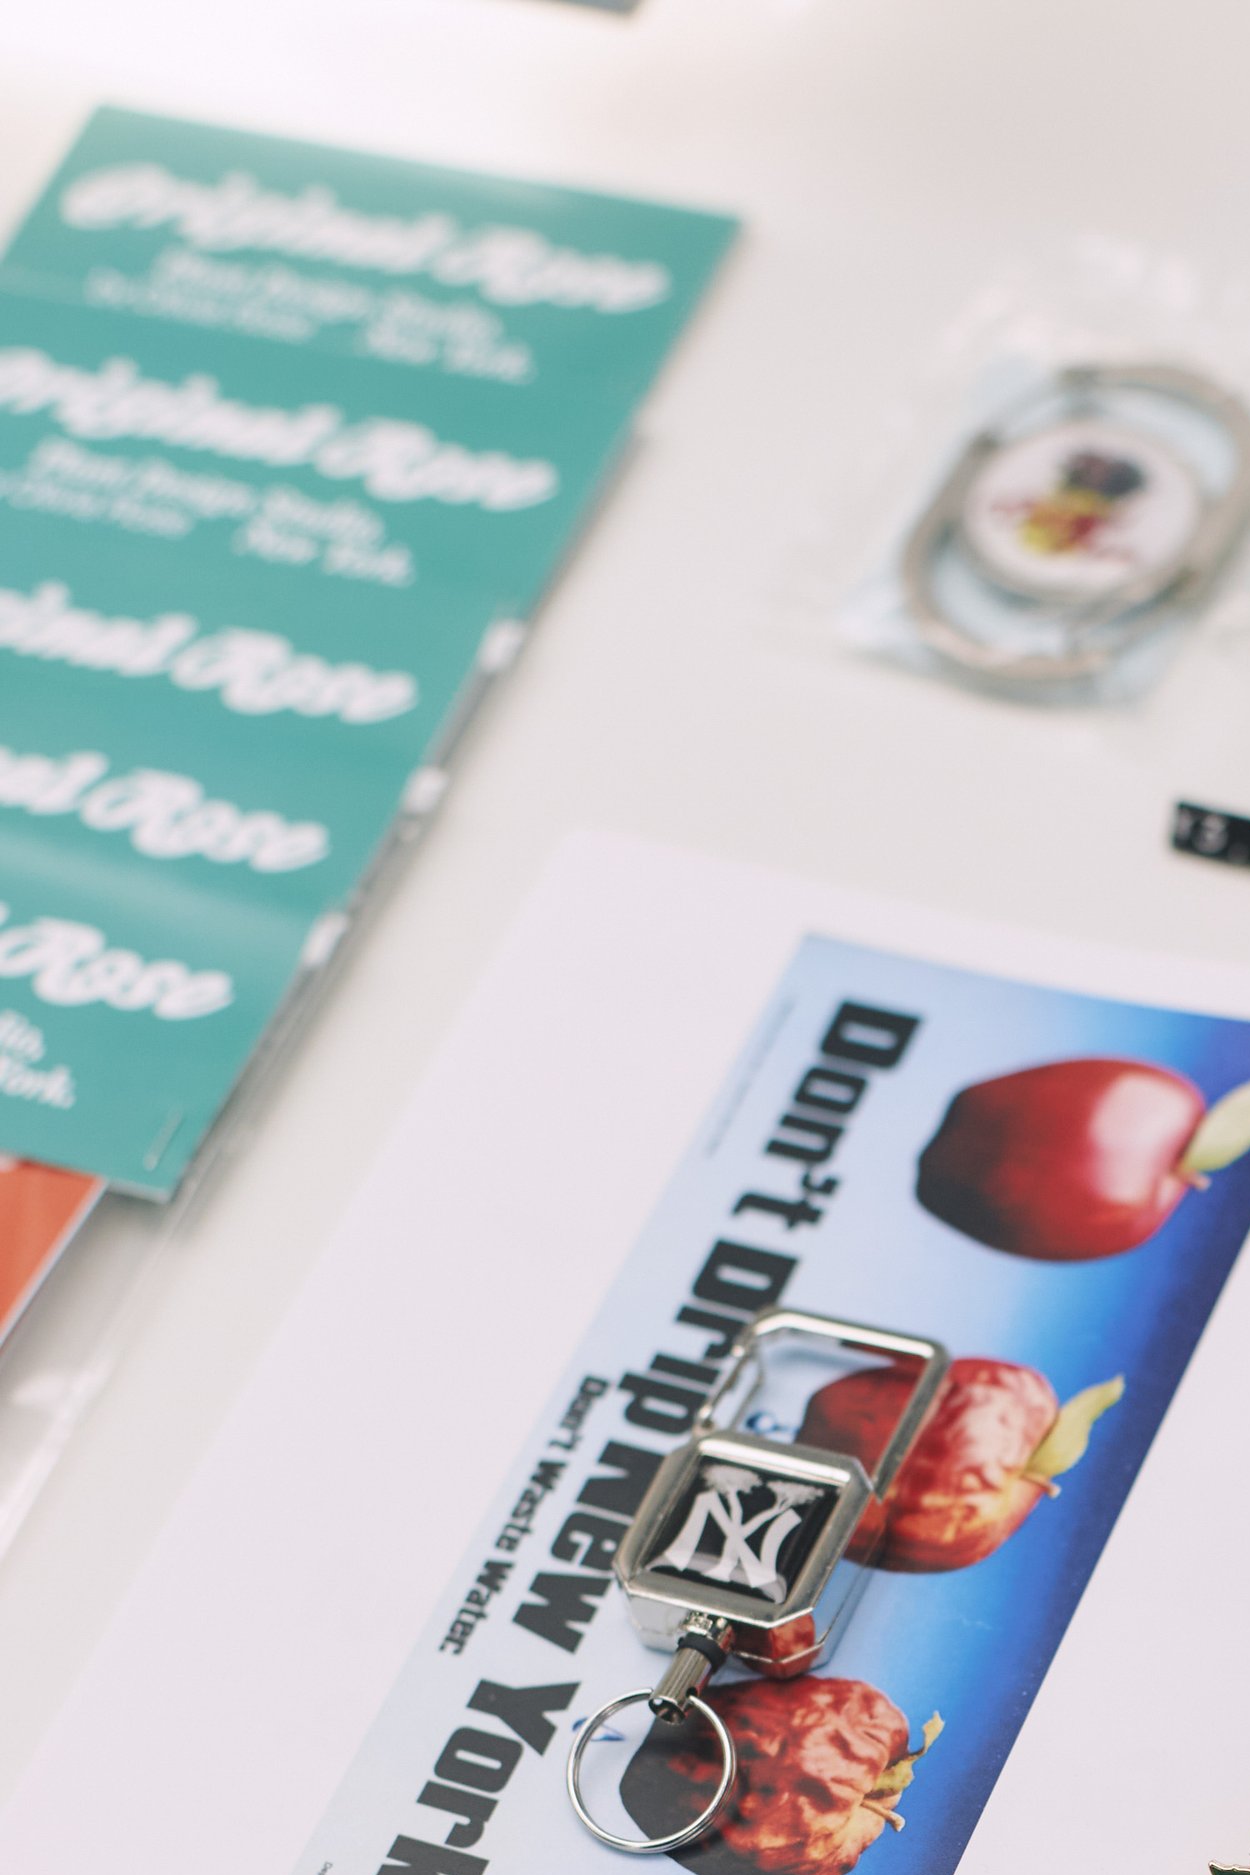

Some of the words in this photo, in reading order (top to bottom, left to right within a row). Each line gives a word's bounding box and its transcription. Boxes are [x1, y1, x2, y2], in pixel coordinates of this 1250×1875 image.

[313, 417, 559, 512] Rose
[170, 627, 418, 724] Rose
[80, 768, 329, 873] Rose
[0, 915, 235, 1021] Rose
[731, 999, 923, 1231] Don't
[618, 1238, 799, 1437] Drip
[551, 1374, 611, 1452] Don't
[495, 1457, 568, 1556] Waste
[512, 1443, 668, 1655] New
